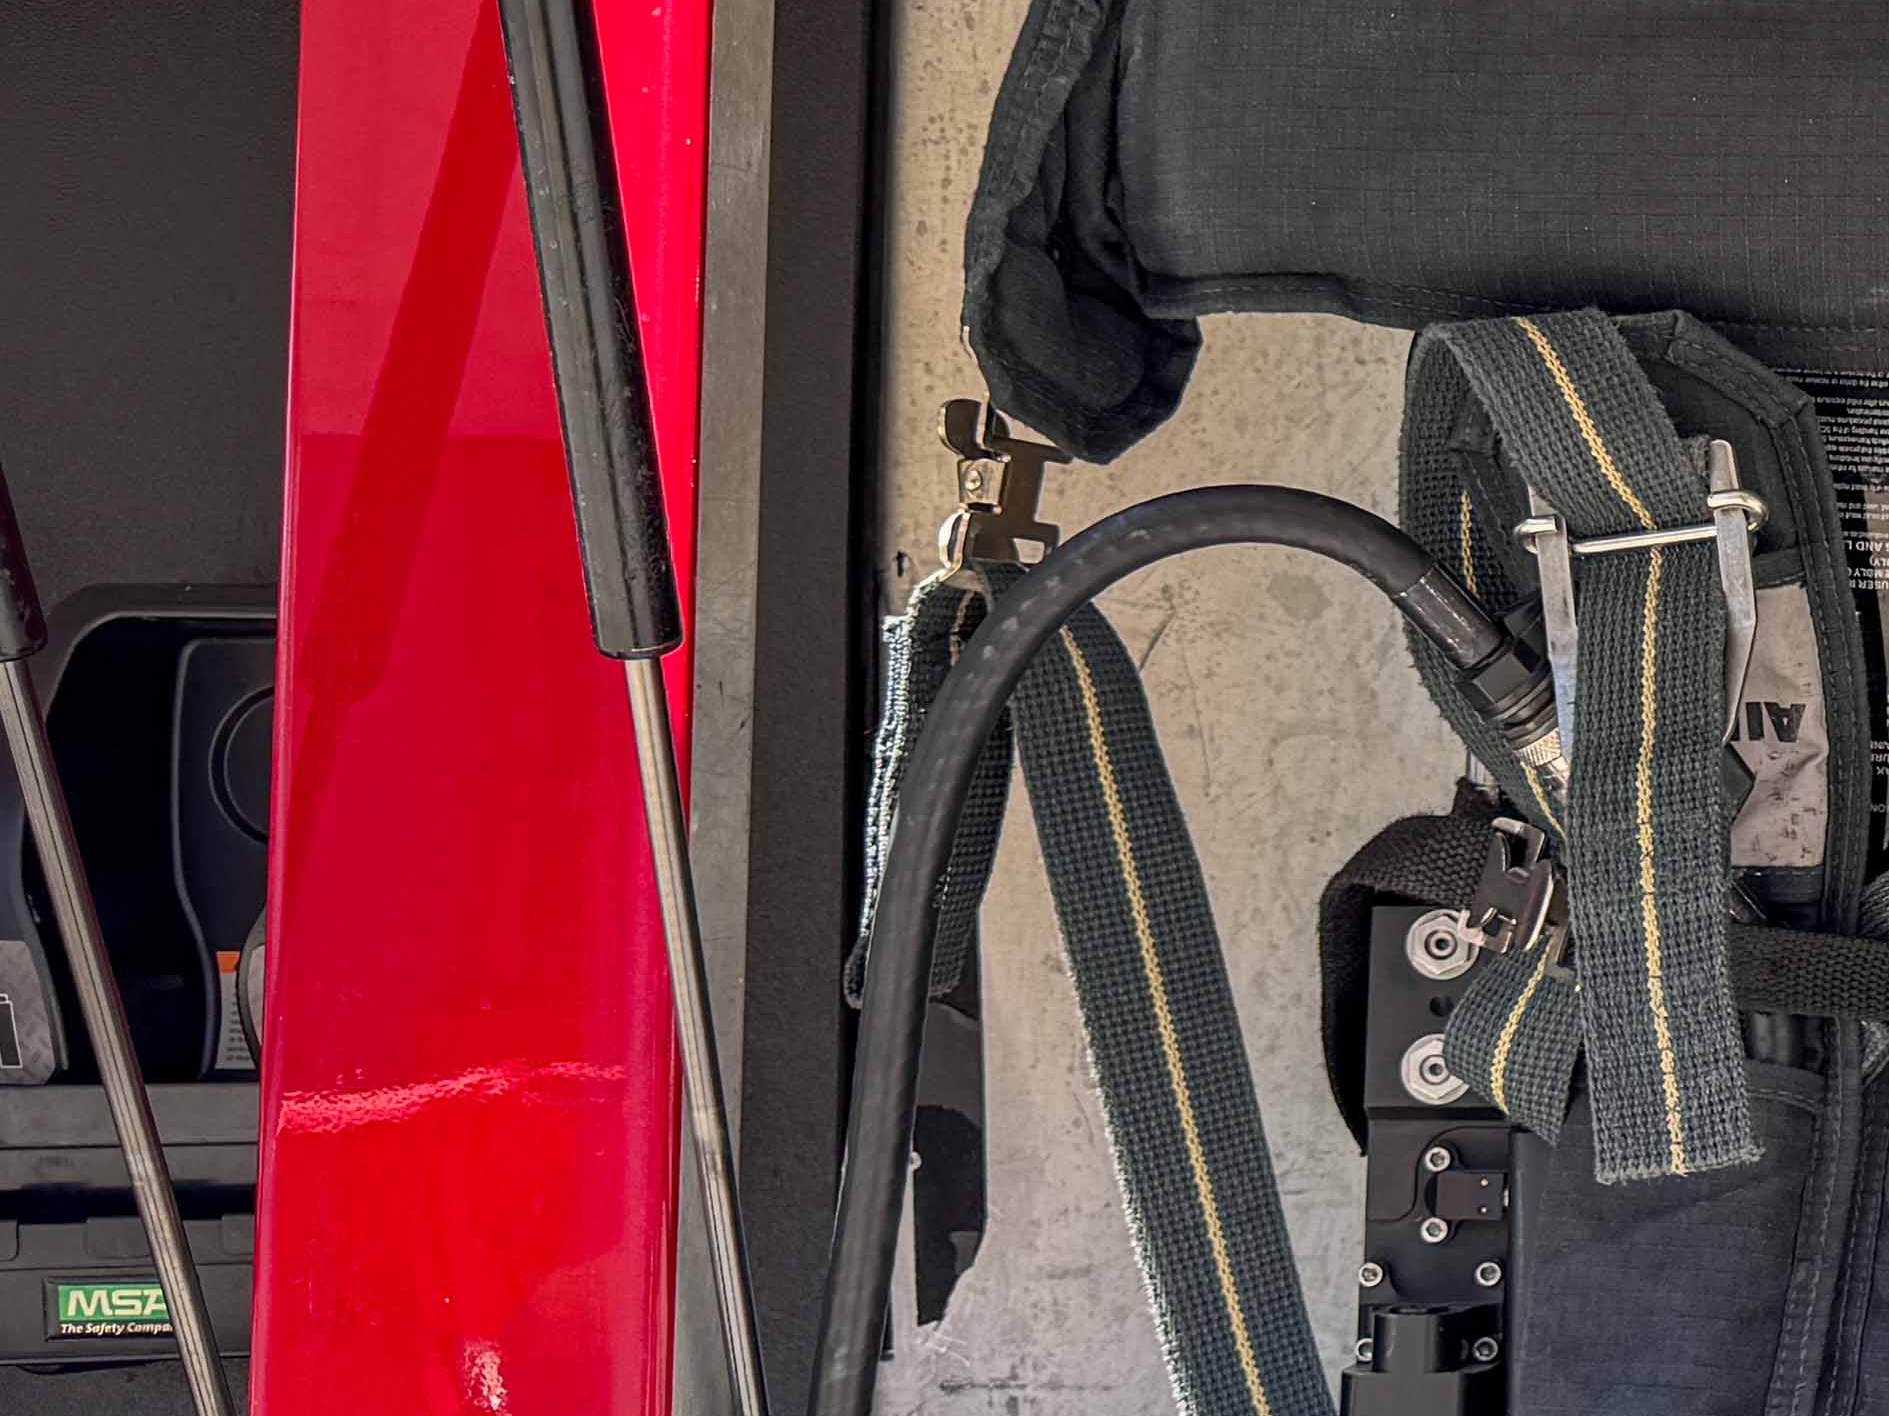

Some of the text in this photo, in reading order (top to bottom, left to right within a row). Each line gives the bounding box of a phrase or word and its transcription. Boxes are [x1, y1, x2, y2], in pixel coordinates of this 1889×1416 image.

[1855, 541, 1883, 551] AND
[1859, 580, 1889, 590] USER
[61, 1324, 83, 1333] The
[85, 1323, 125, 1335] Safety
